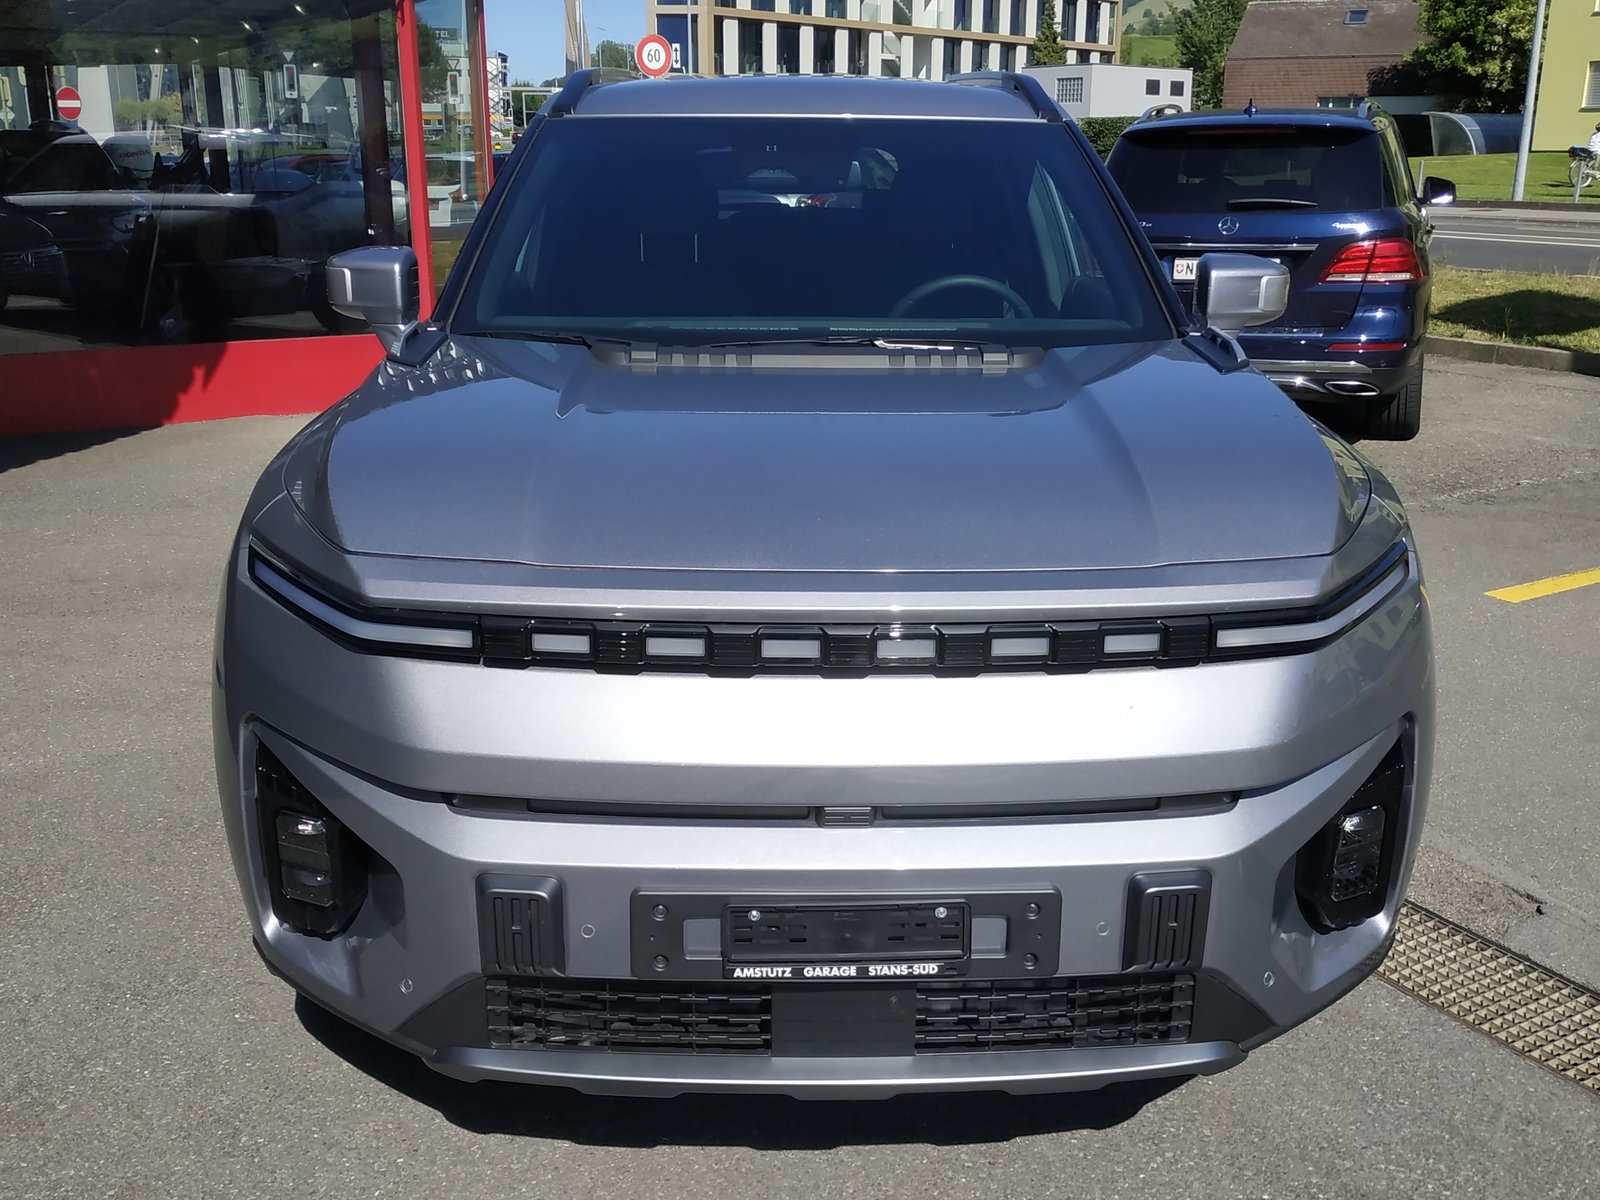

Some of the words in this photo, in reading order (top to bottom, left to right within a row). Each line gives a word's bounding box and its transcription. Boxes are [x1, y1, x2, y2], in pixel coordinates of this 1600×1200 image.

[647, 48, 661, 63] 60
[733, 966, 793, 978] AMSTUTZ
[803, 965, 857, 977] GARAGE
